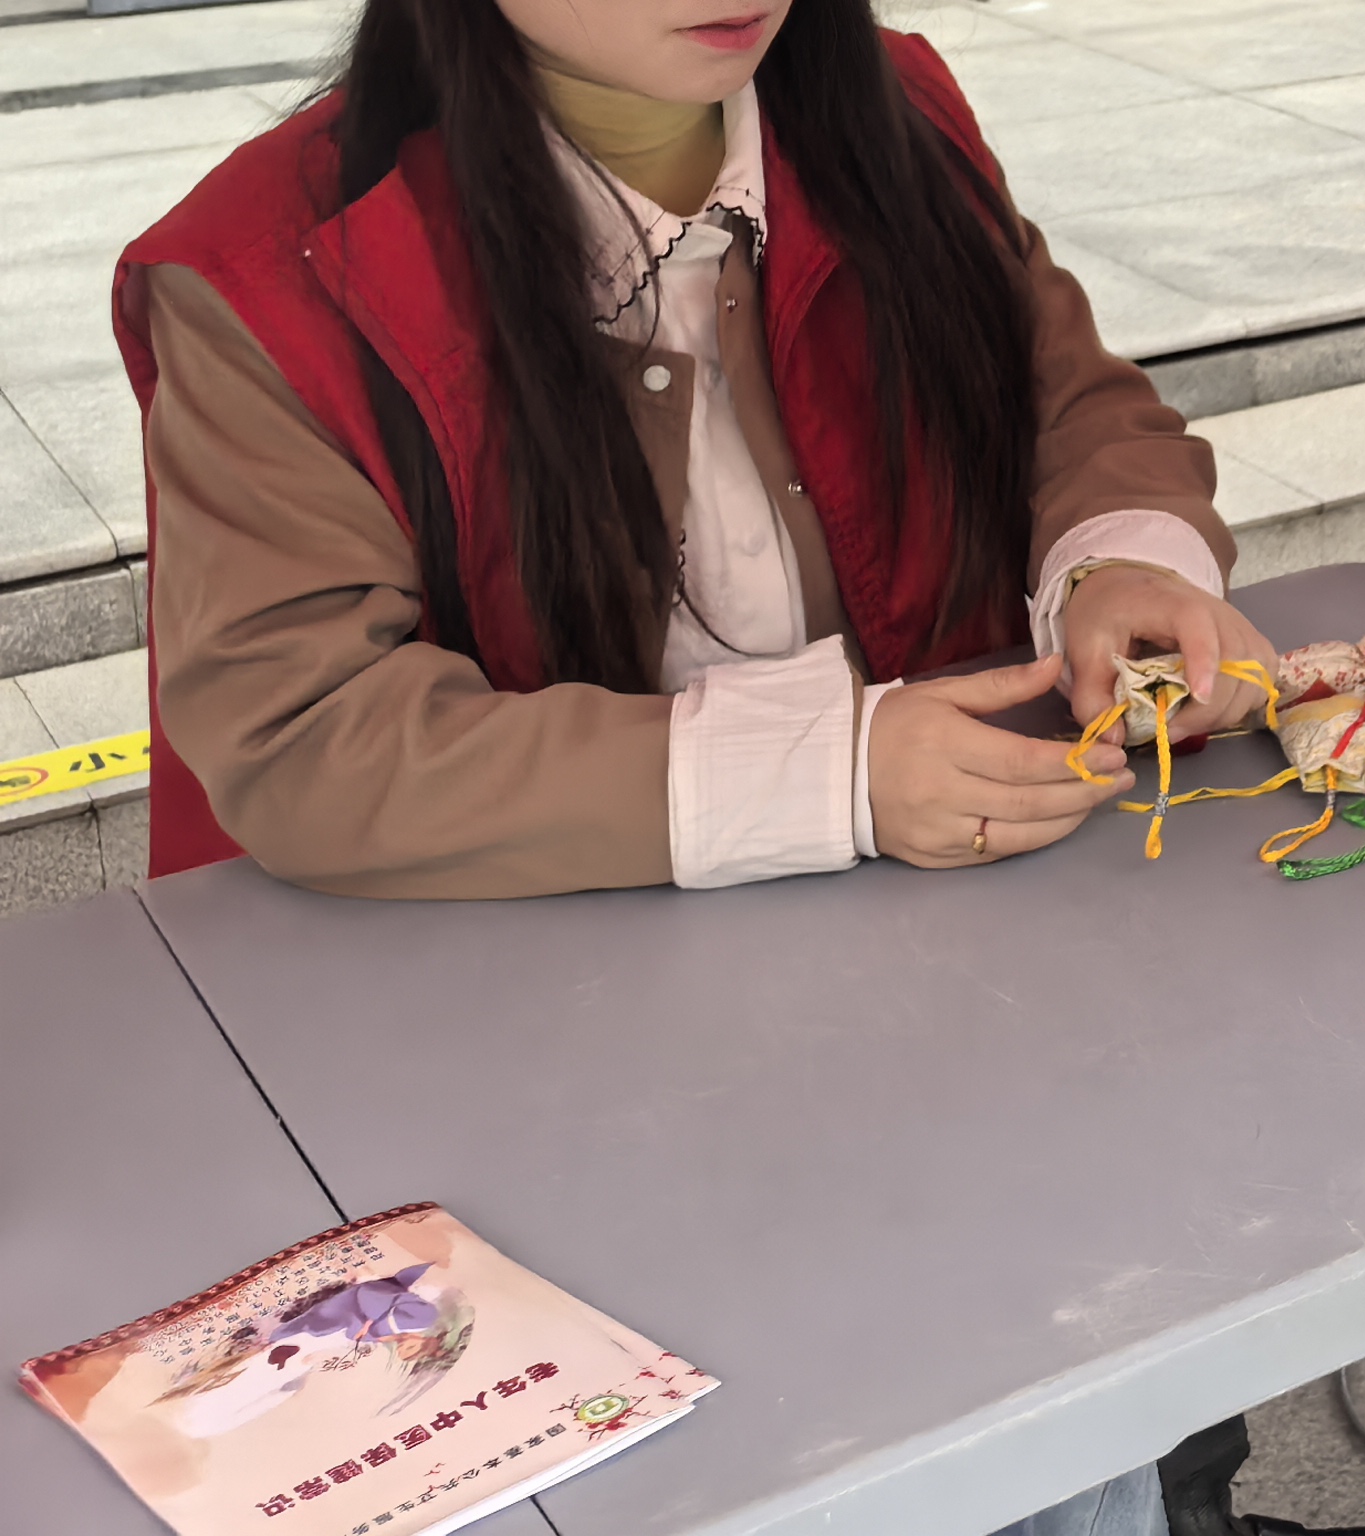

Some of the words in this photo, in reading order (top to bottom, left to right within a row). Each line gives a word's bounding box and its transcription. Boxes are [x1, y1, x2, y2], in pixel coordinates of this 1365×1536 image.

[253, 1360, 562, 1518] 老年人中医保健常识
[343, 1422, 567, 1536] 国家基本公共卫生服务
